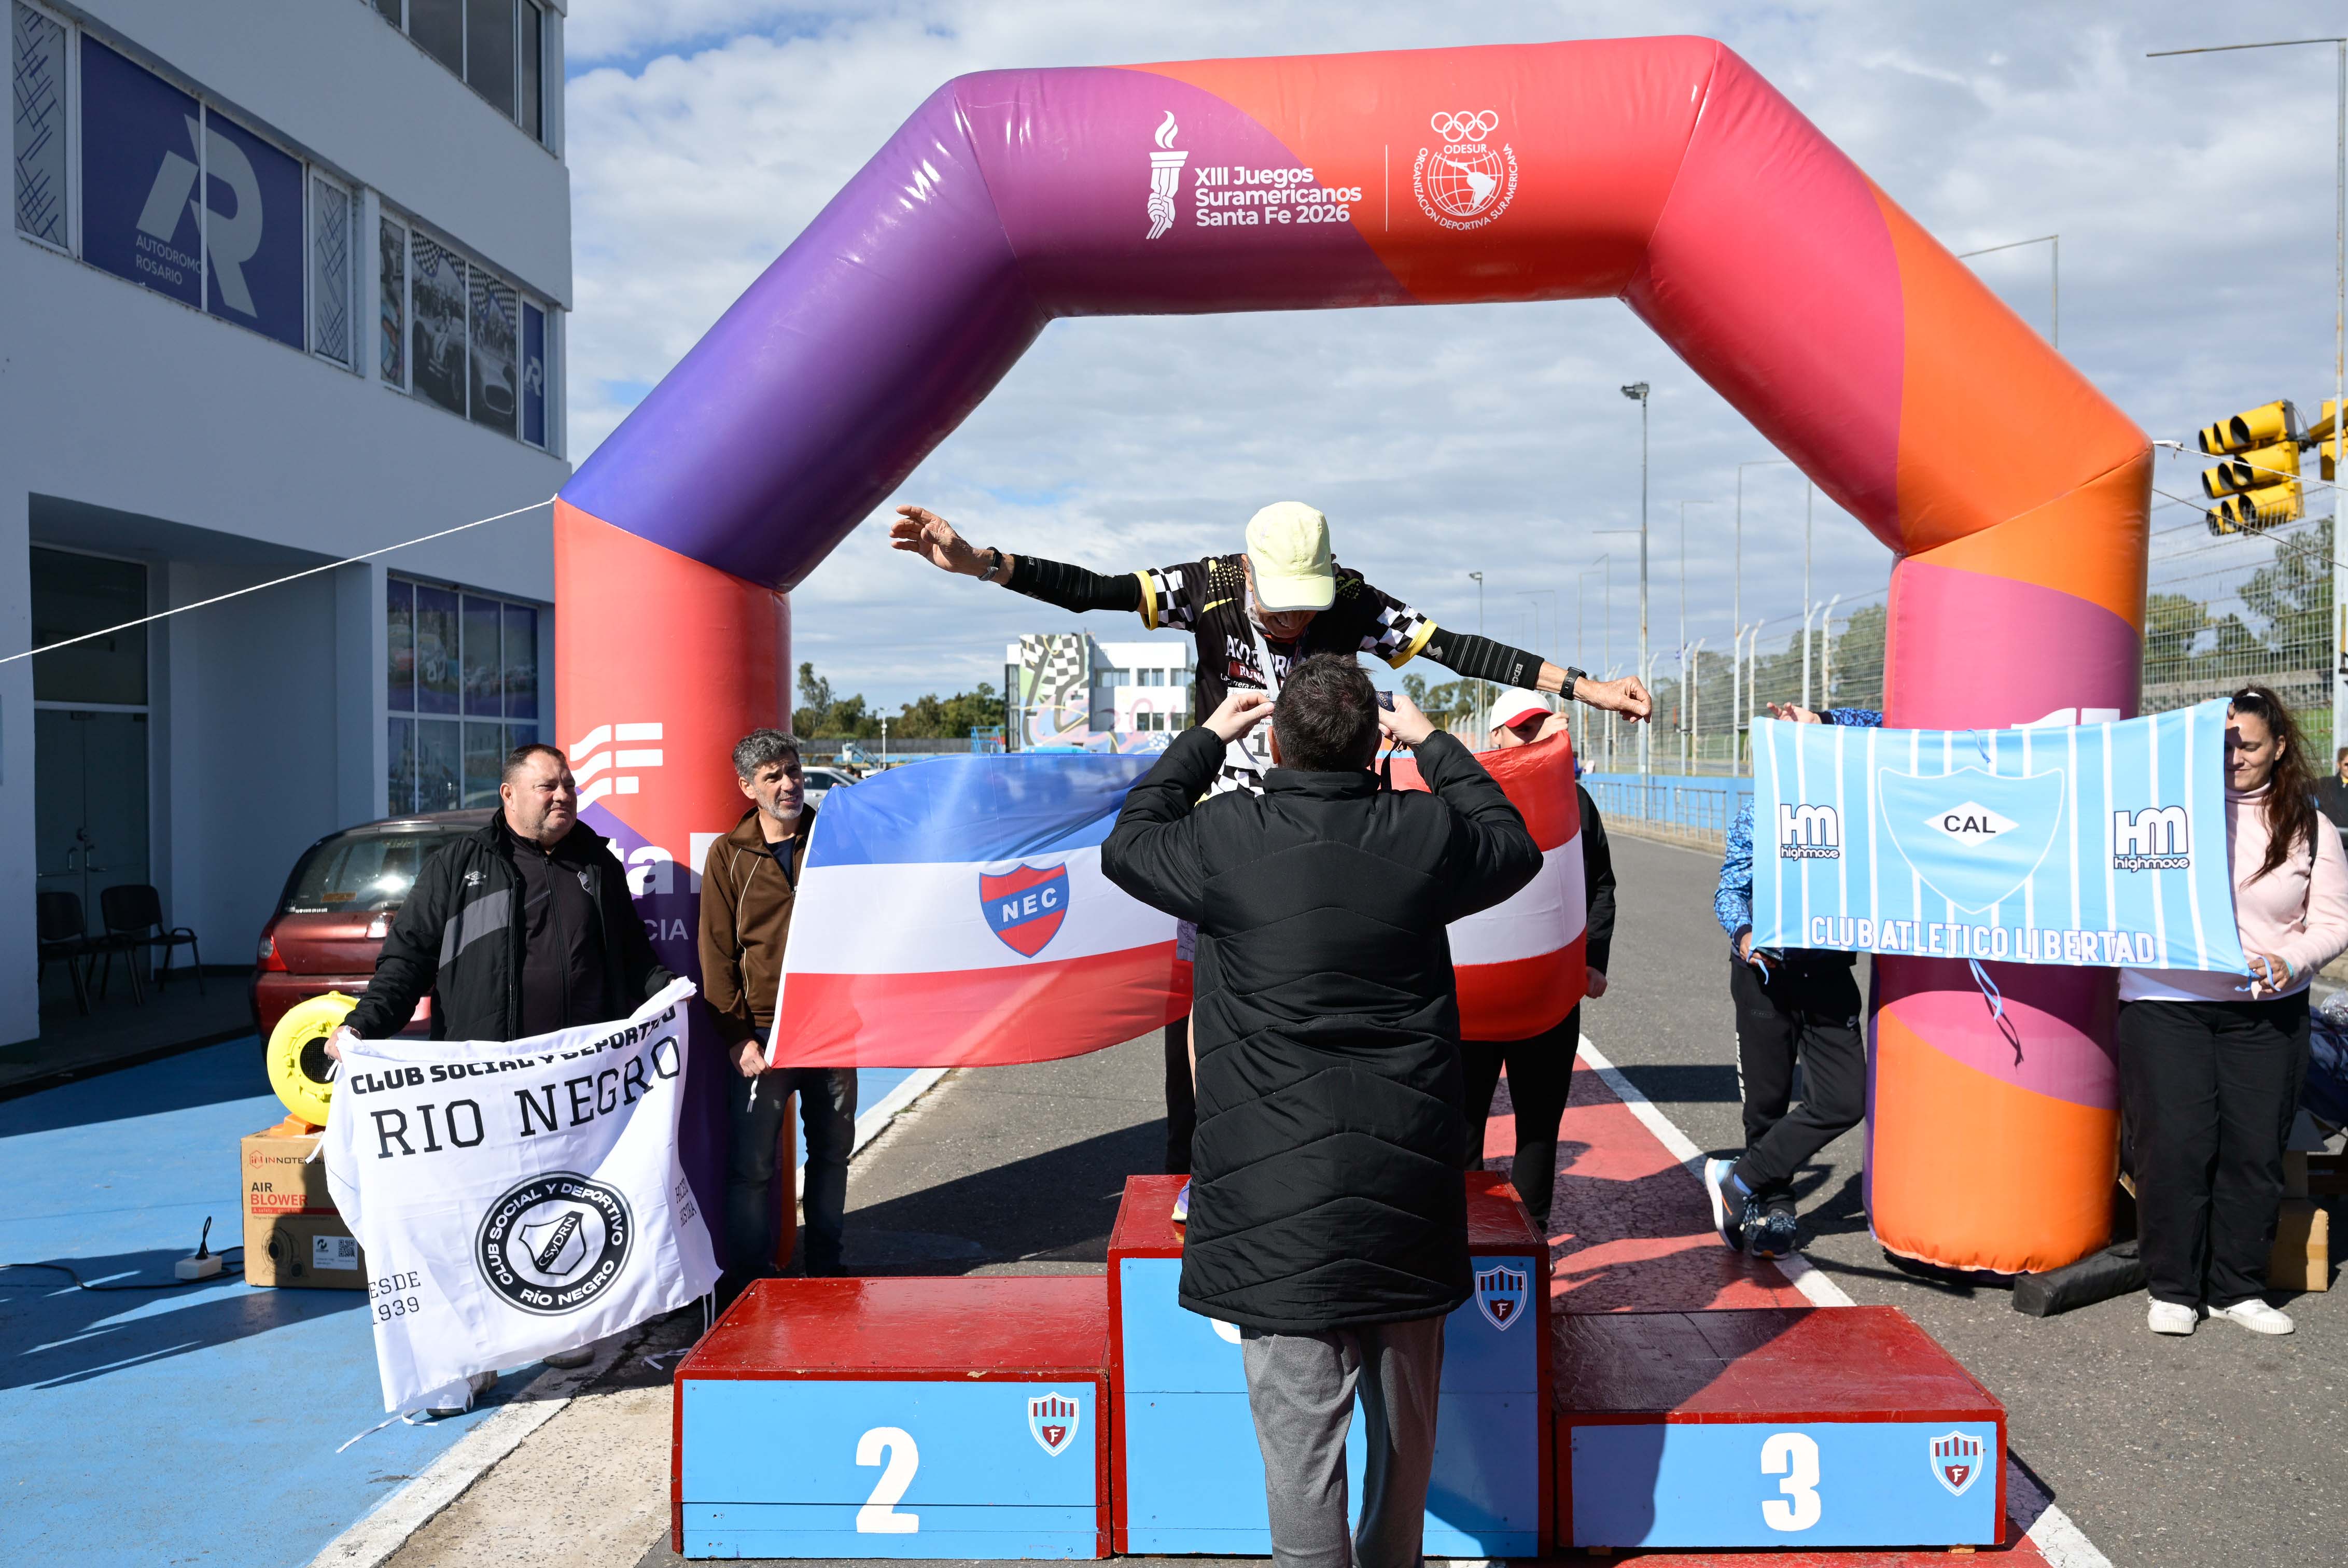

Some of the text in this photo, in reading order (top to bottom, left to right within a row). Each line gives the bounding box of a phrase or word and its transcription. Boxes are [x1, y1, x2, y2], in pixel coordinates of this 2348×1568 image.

[1444, 144, 1487, 154] ODESUR
[1194, 166, 1314, 188] XIII Juegos
[1413, 143, 1518, 231] ORGANIZACION DEPORTIVA SURAMERICANA
[1195, 184, 1362, 206] Suramericanos
[1196, 204, 1350, 227] Santa Fe 2026
[136, 255, 183, 285] ROSARIO
[1944, 815, 1996, 834] CAL
[1780, 846, 1840, 861] highmove
[2113, 856, 2190, 873] highmove
[1002, 888, 1057, 922] NEC
[1810, 916, 2156, 963] CLUB ATLETICO LIBERTAD
[351, 1067, 425, 1095] CLUB
[429, 1058, 535, 1083] SOCIAL
[370, 1036, 680, 1159] RIO NEGRO
[251, 1182, 272, 1192] AIR
[251, 1194, 308, 1206] BLOWER
[546, 1183, 557, 1195] Y
[490, 1189, 542, 1240] SOCIAL
[561, 1183, 623, 1246] DEPORTIVO
[538, 1216, 576, 1267] CSyDRN
[487, 1243, 513, 1285] CLUB
[558, 1260, 614, 1305] NEGRO
[372, 1296, 420, 1325] 939
[1495, 1301, 1509, 1317] F
[1048, 1427, 1061, 1443] F
[856, 1426, 919, 1533] 2
[1760, 1432, 1821, 1531] 3
[1951, 1467, 1964, 1483] F
